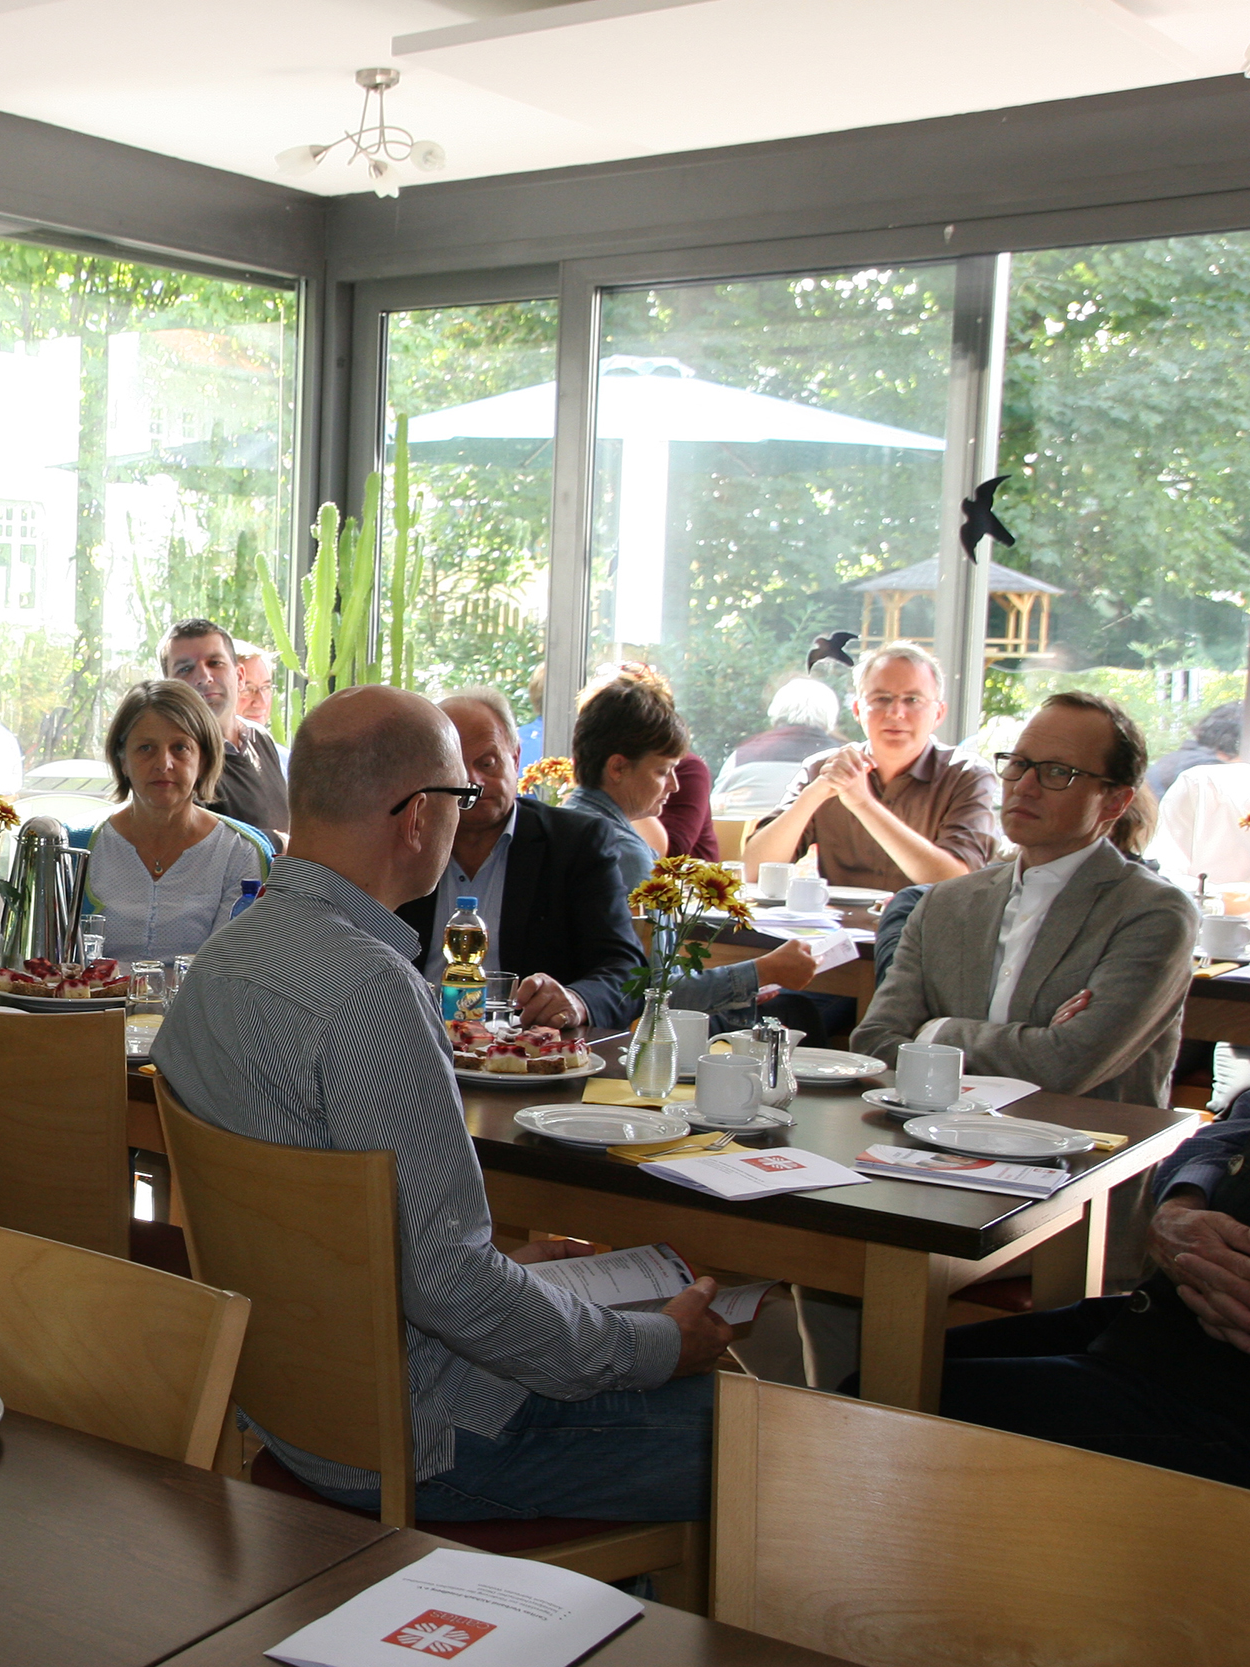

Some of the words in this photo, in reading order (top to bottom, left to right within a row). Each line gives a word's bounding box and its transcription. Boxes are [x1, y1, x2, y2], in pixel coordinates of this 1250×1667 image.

[492, 1602, 521, 1612] Verband
[430, 1611, 490, 1629] caritas
[524, 1610, 547, 1621] Caritas
